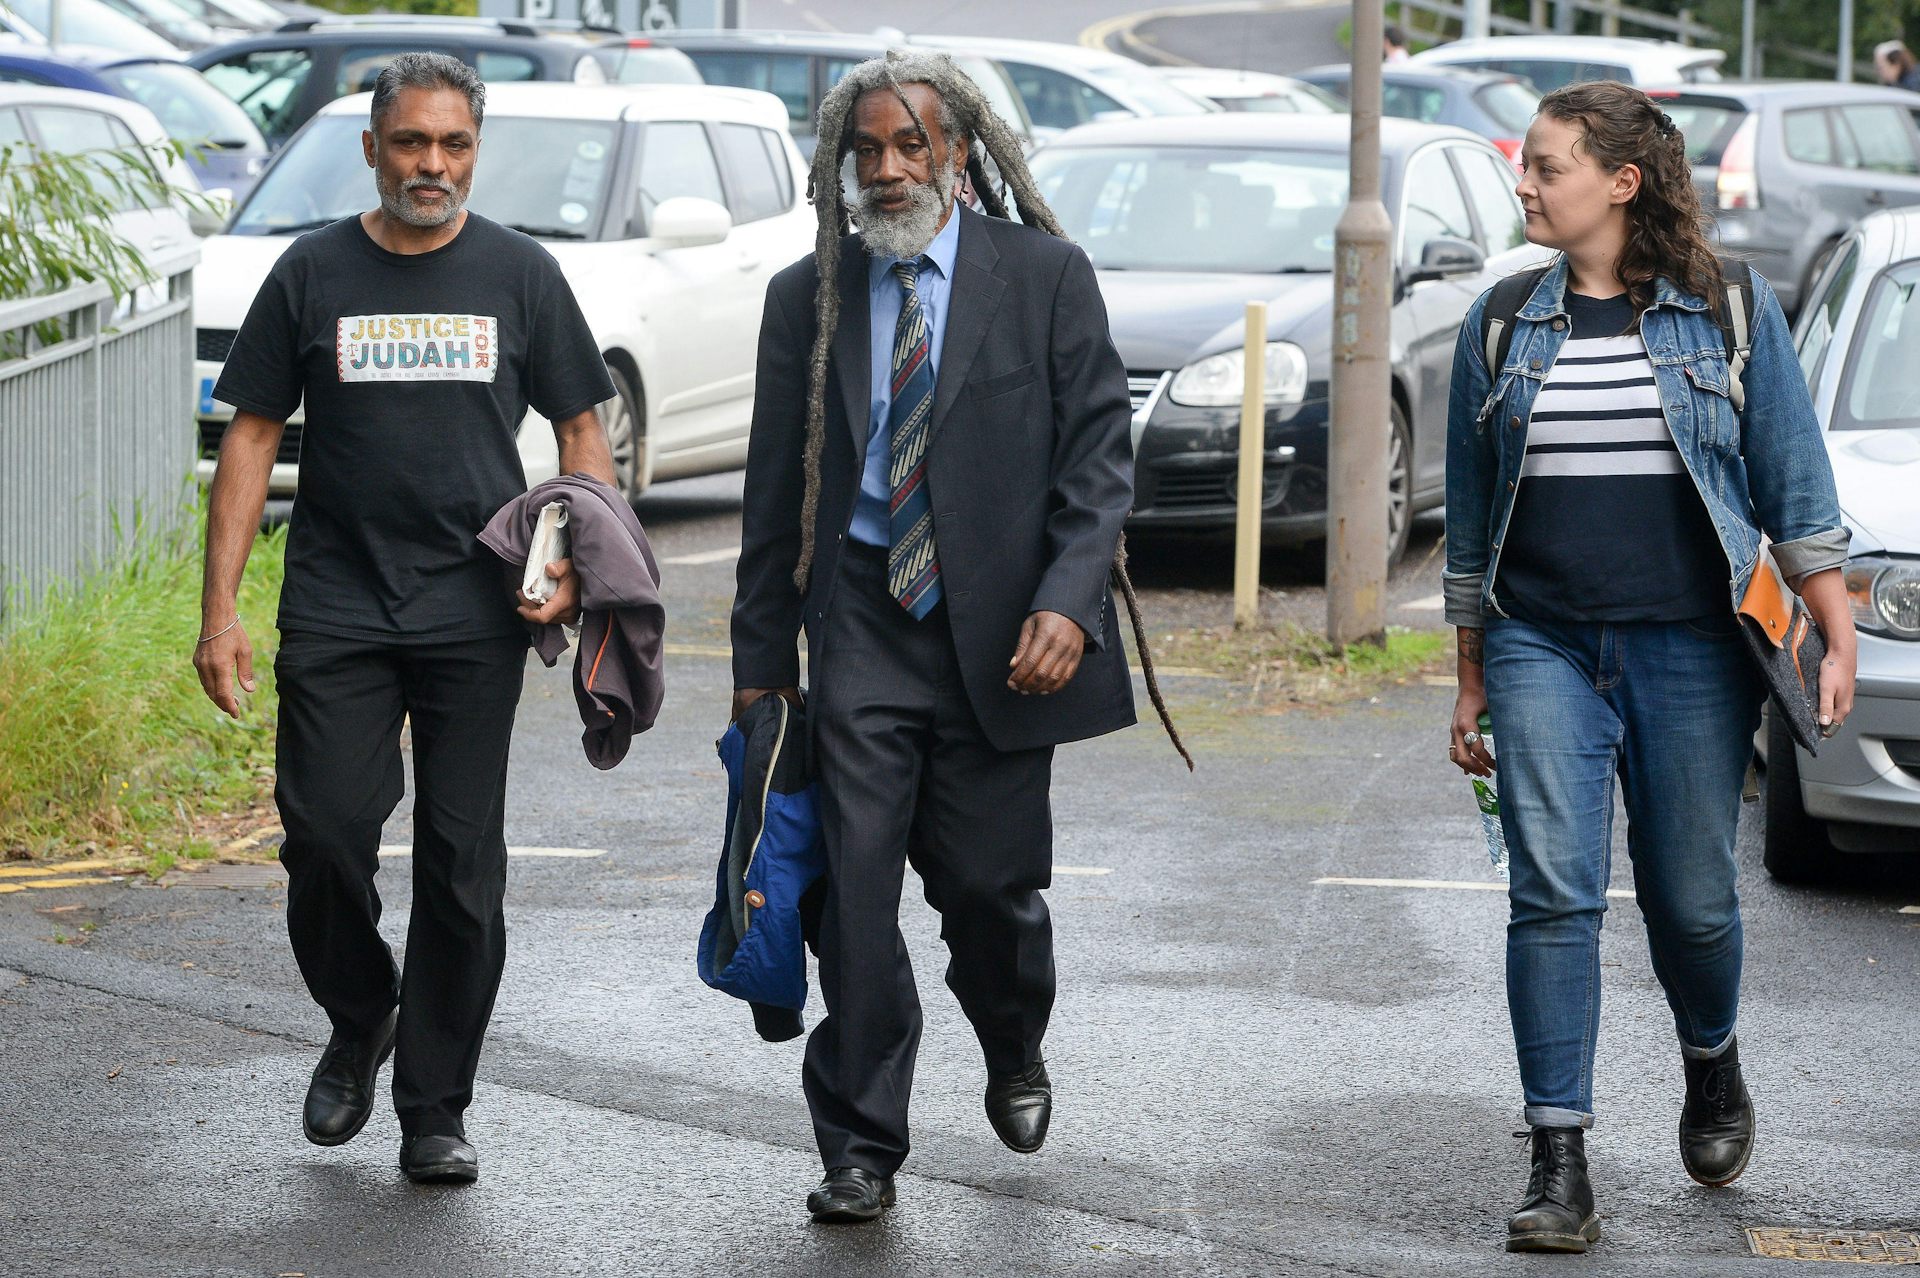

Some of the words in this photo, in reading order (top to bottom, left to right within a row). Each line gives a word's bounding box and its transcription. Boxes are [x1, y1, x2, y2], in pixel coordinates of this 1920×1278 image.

[350, 316, 470, 340] JUSTICE
[350, 340, 470, 370] JUDAH
[474, 318, 489, 369] FOR
